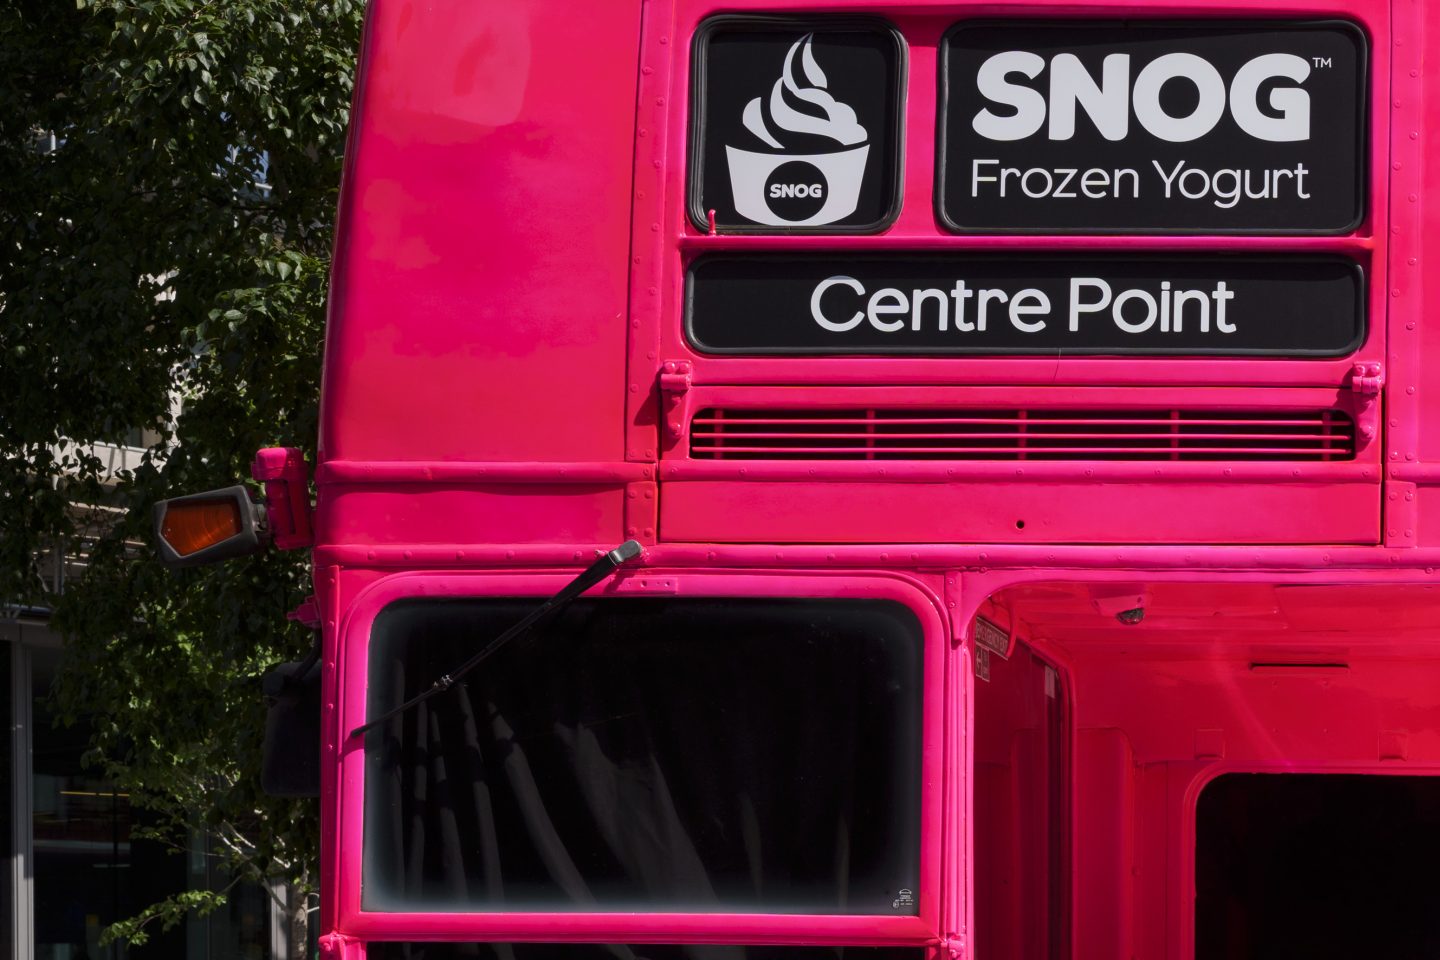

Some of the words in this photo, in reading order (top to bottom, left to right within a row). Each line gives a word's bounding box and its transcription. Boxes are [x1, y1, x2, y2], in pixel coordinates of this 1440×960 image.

[971, 50, 1311, 143] SNOG
[769, 182, 823, 199] SNOG
[971, 159, 1140, 200] Frozen
[1151, 159, 1310, 209] Yogurt
[810, 275, 1051, 333] Centre
[1069, 276, 1237, 334] Point
